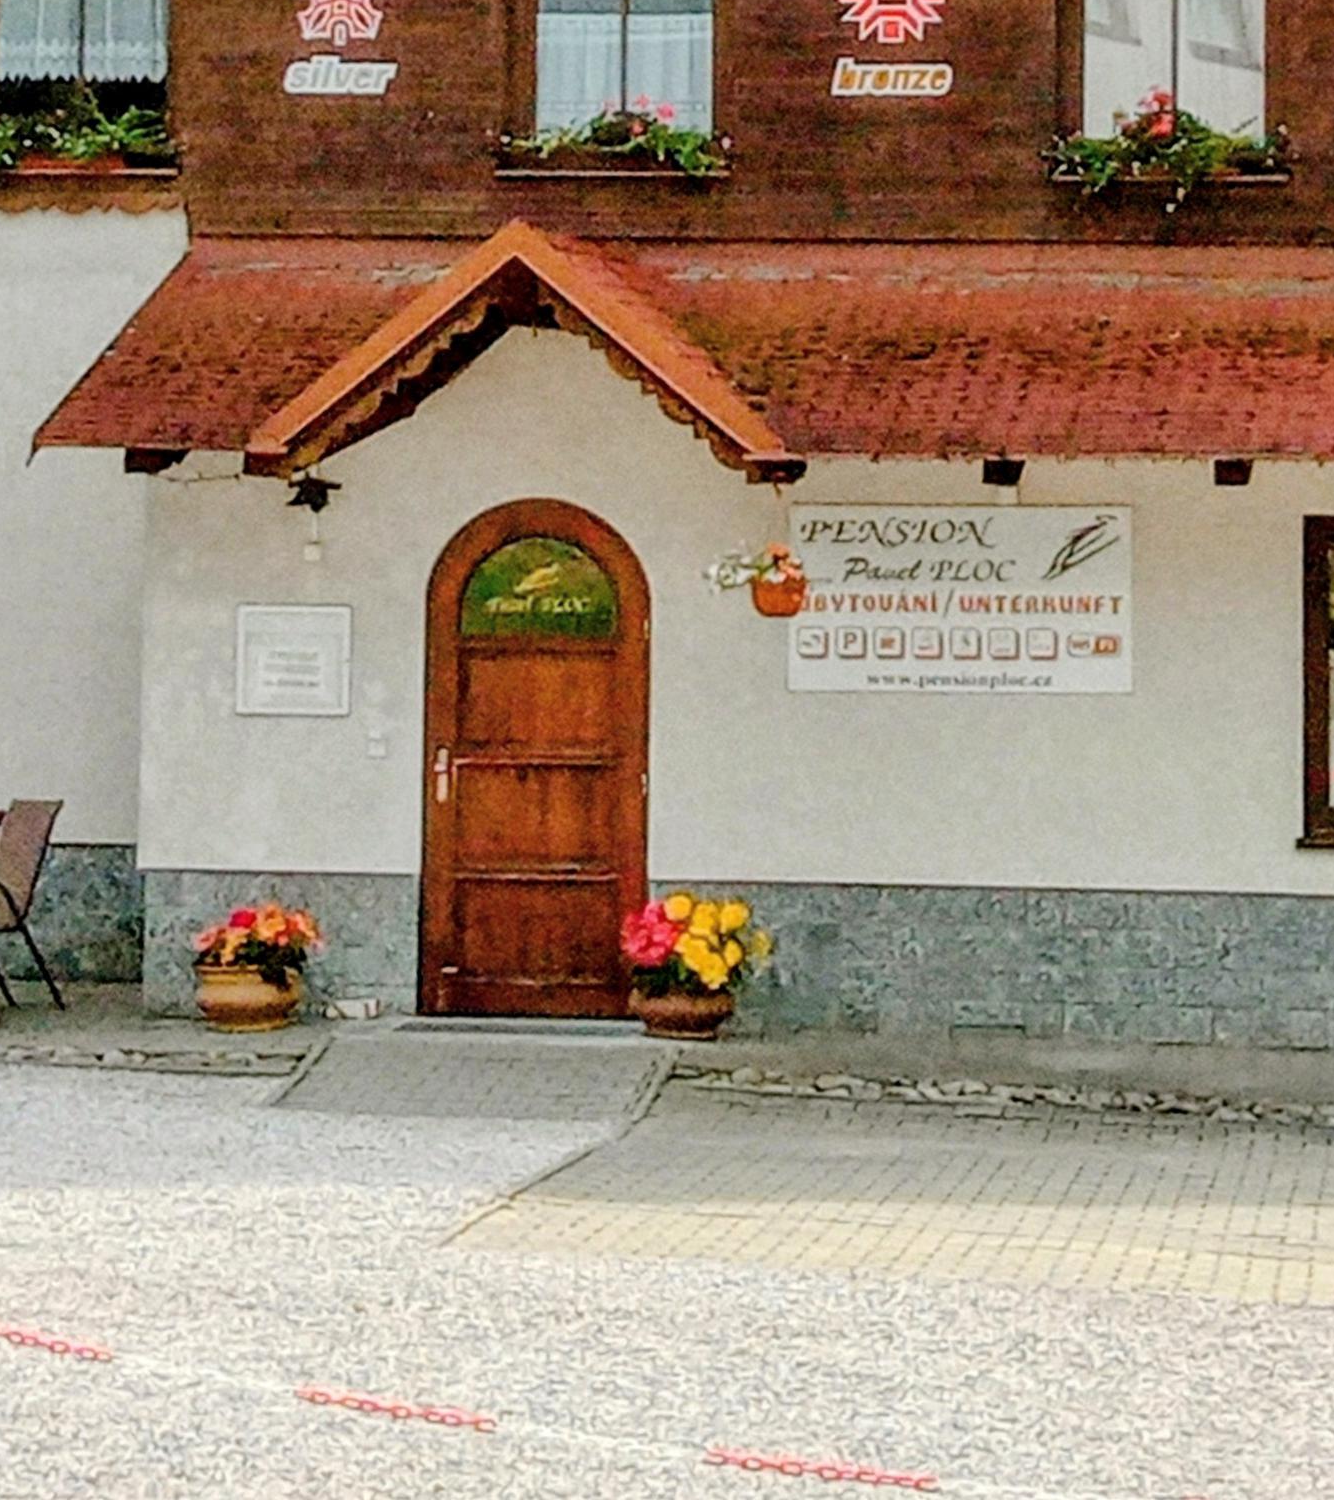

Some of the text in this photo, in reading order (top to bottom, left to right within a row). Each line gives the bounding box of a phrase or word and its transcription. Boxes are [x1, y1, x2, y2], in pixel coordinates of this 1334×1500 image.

[288, 58, 391, 90] silver
[836, 61, 948, 92] bronze
[800, 516, 997, 549] PENSION
[843, 556, 1017, 583] Pavel PLOC
